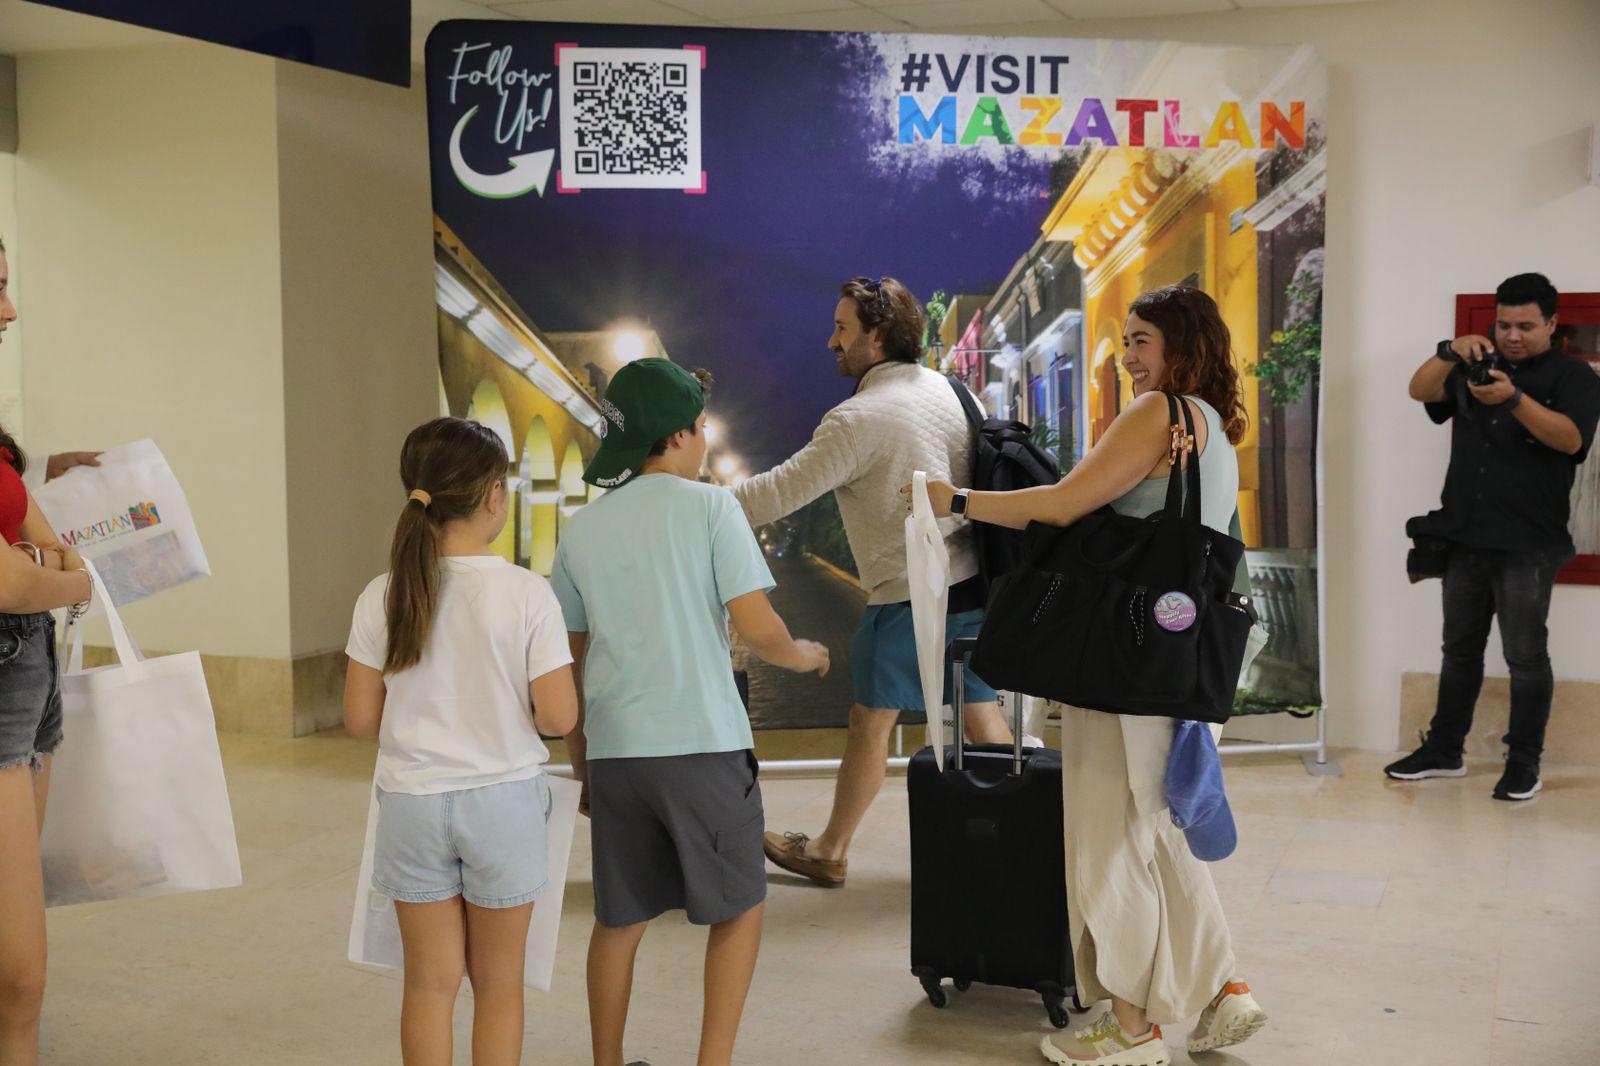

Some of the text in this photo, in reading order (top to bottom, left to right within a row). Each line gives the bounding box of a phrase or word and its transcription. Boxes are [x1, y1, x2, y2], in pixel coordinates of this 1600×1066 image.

[447, 42, 552, 104] Follow
[900, 53, 1070, 95] #VISIT
[494, 87, 552, 151] Us!
[898, 95, 1306, 149] MAZATLAN
[595, 468, 633, 487] SCOTLAND
